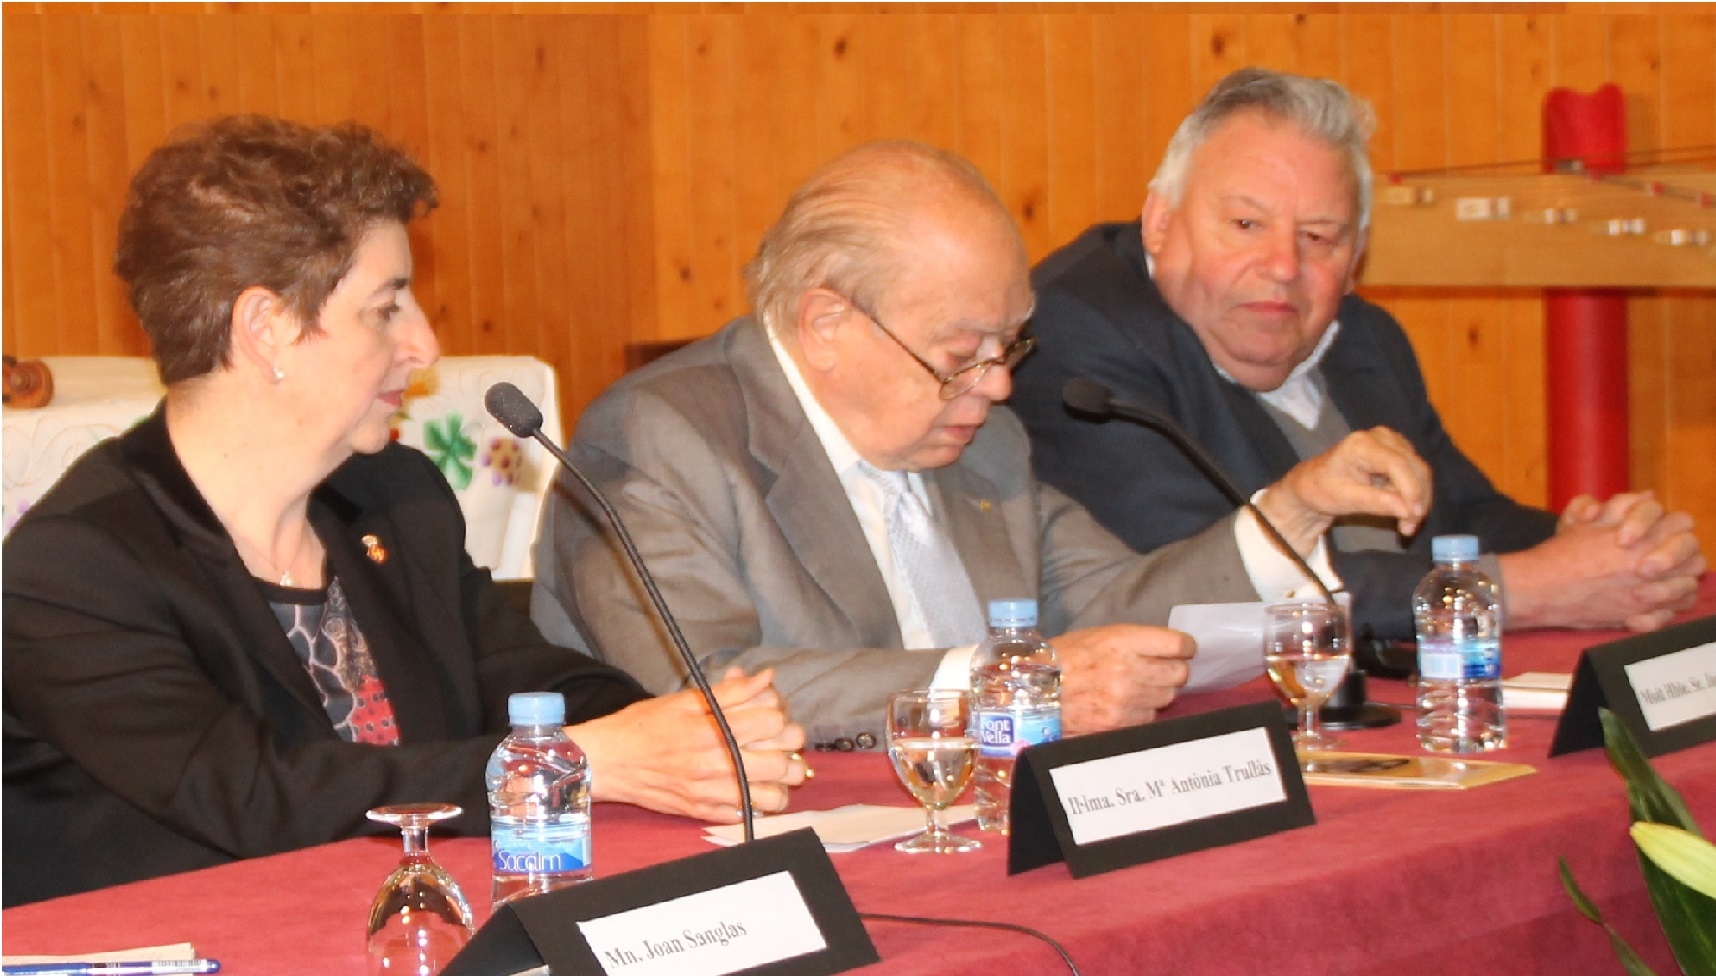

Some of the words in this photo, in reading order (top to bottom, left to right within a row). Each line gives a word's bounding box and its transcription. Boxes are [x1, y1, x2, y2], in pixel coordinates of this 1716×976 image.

[981, 730, 1012, 744] Vella
[1115, 787, 1145, 806] Sra.
[1145, 779, 1165, 800] Mª
[498, 850, 562, 872] Sacalm
[604, 946, 644, 969] Mn.
[642, 939, 685, 960] Joan
[682, 921, 748, 947] Sanglas
